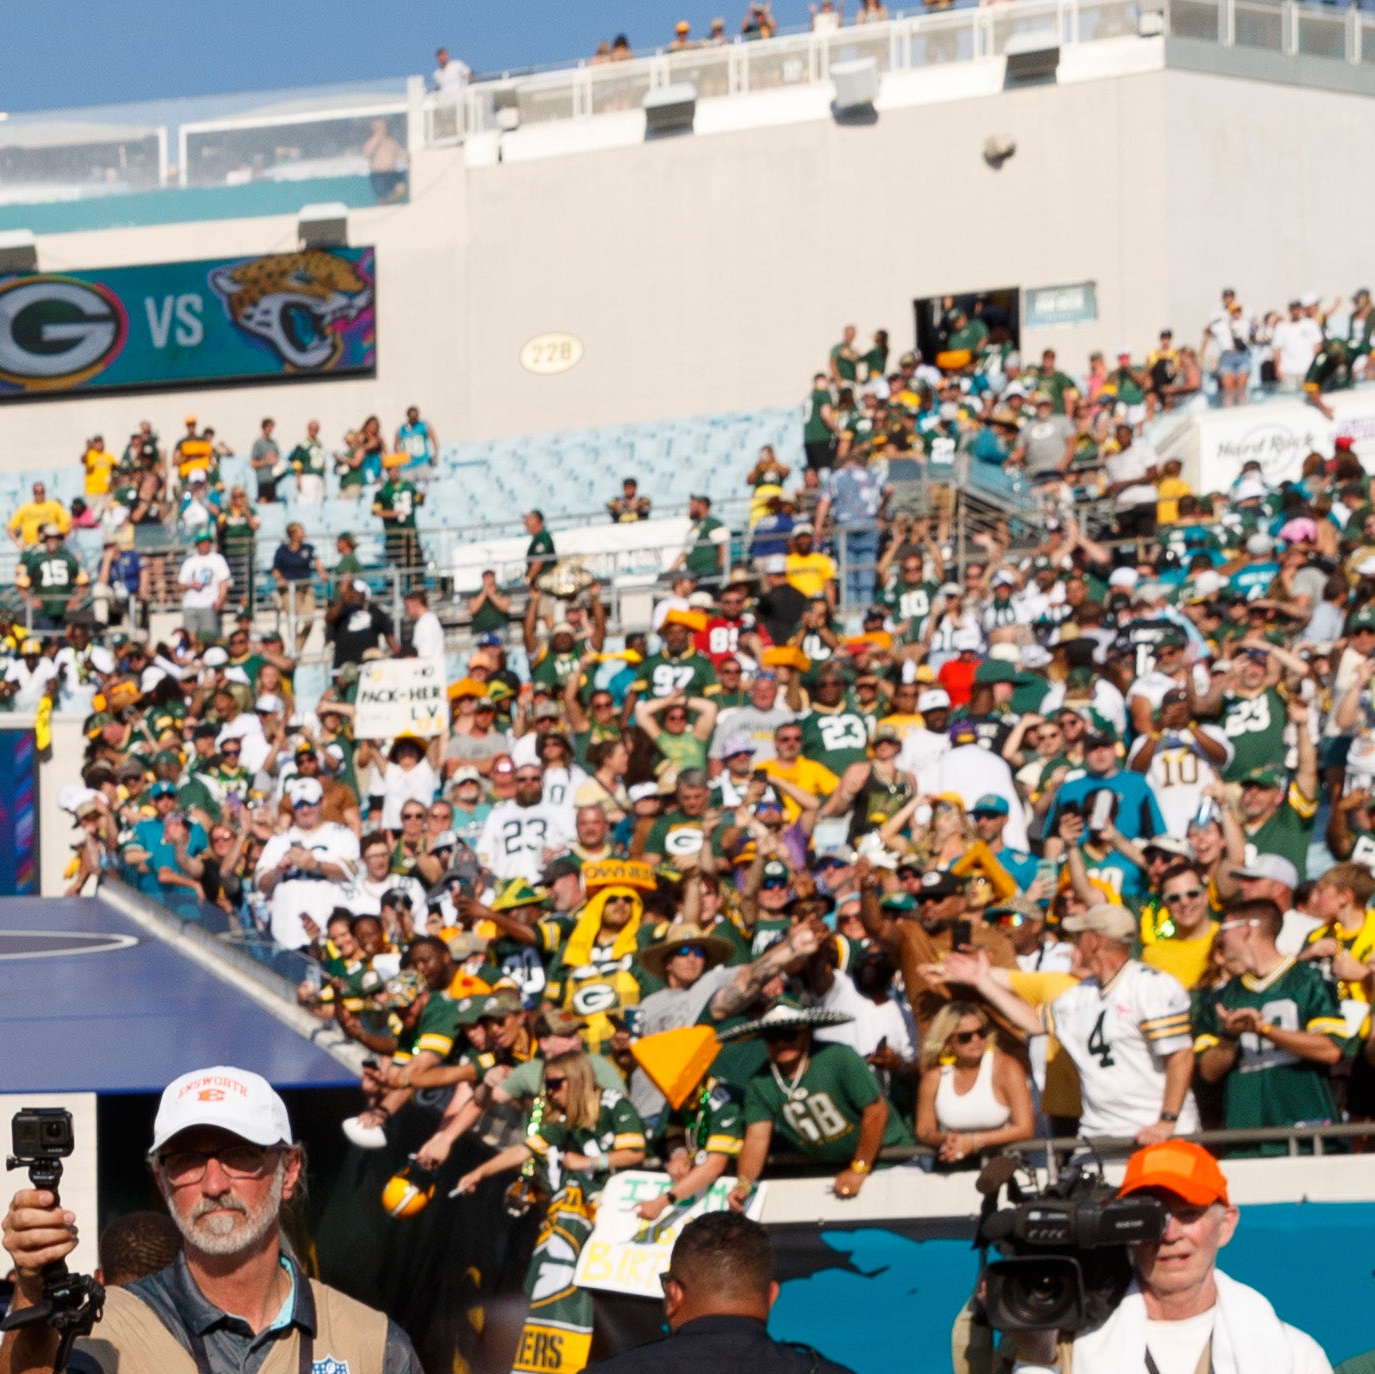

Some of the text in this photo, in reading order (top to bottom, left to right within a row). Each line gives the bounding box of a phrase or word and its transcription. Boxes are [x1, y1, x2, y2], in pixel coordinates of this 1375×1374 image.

[144, 293, 204, 349] VS
[653, 664, 695, 697] 97
[817, 713, 868, 752] 23
[1162, 752, 1200, 789] 10
[502, 818, 549, 857] 23
[1087, 1010, 1117, 1069] 4
[782, 1092, 849, 1142] GB
